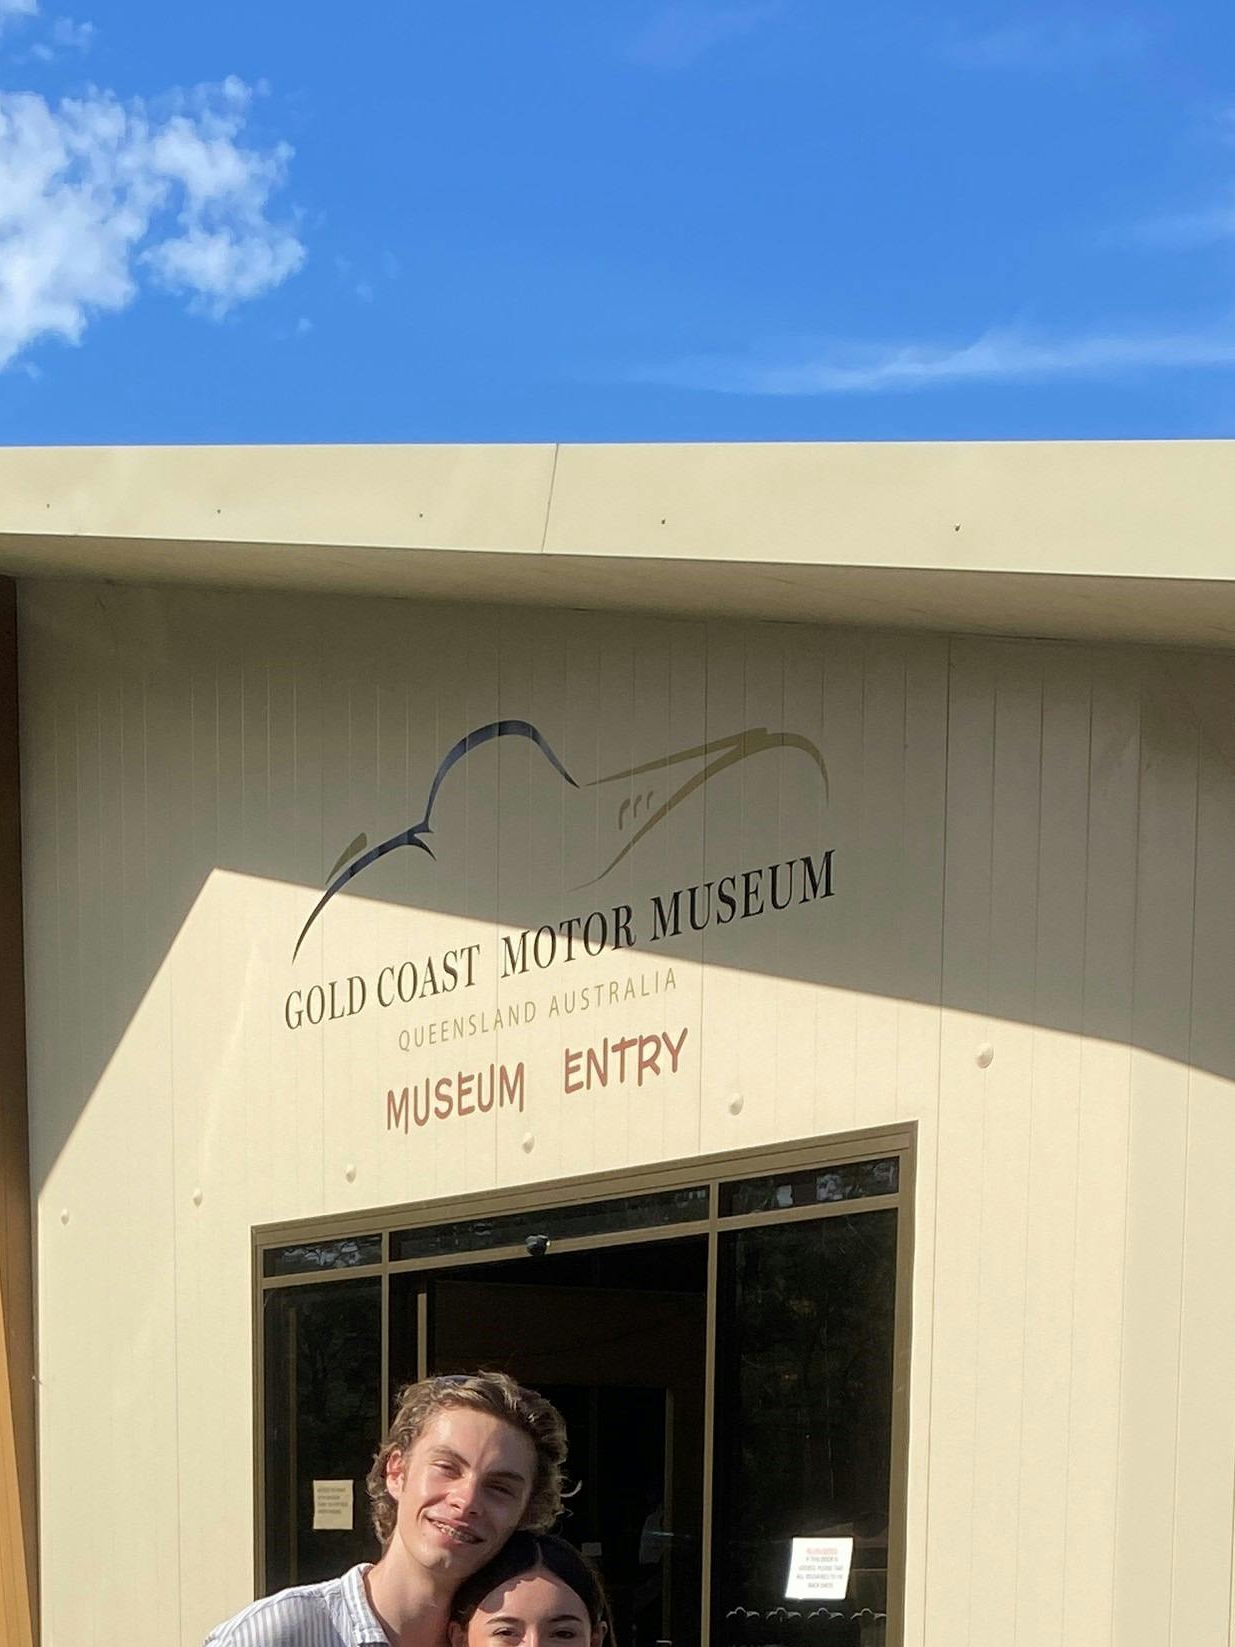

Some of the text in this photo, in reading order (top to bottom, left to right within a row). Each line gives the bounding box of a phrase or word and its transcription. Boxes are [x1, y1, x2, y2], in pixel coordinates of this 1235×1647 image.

[284, 849, 836, 1030] GOLD COAST MOTOR MUSEUM
[398, 967, 677, 1052] QUEENSLAND AUSTRALIA
[386, 1027, 689, 1135] MUSEUM ENTRY
